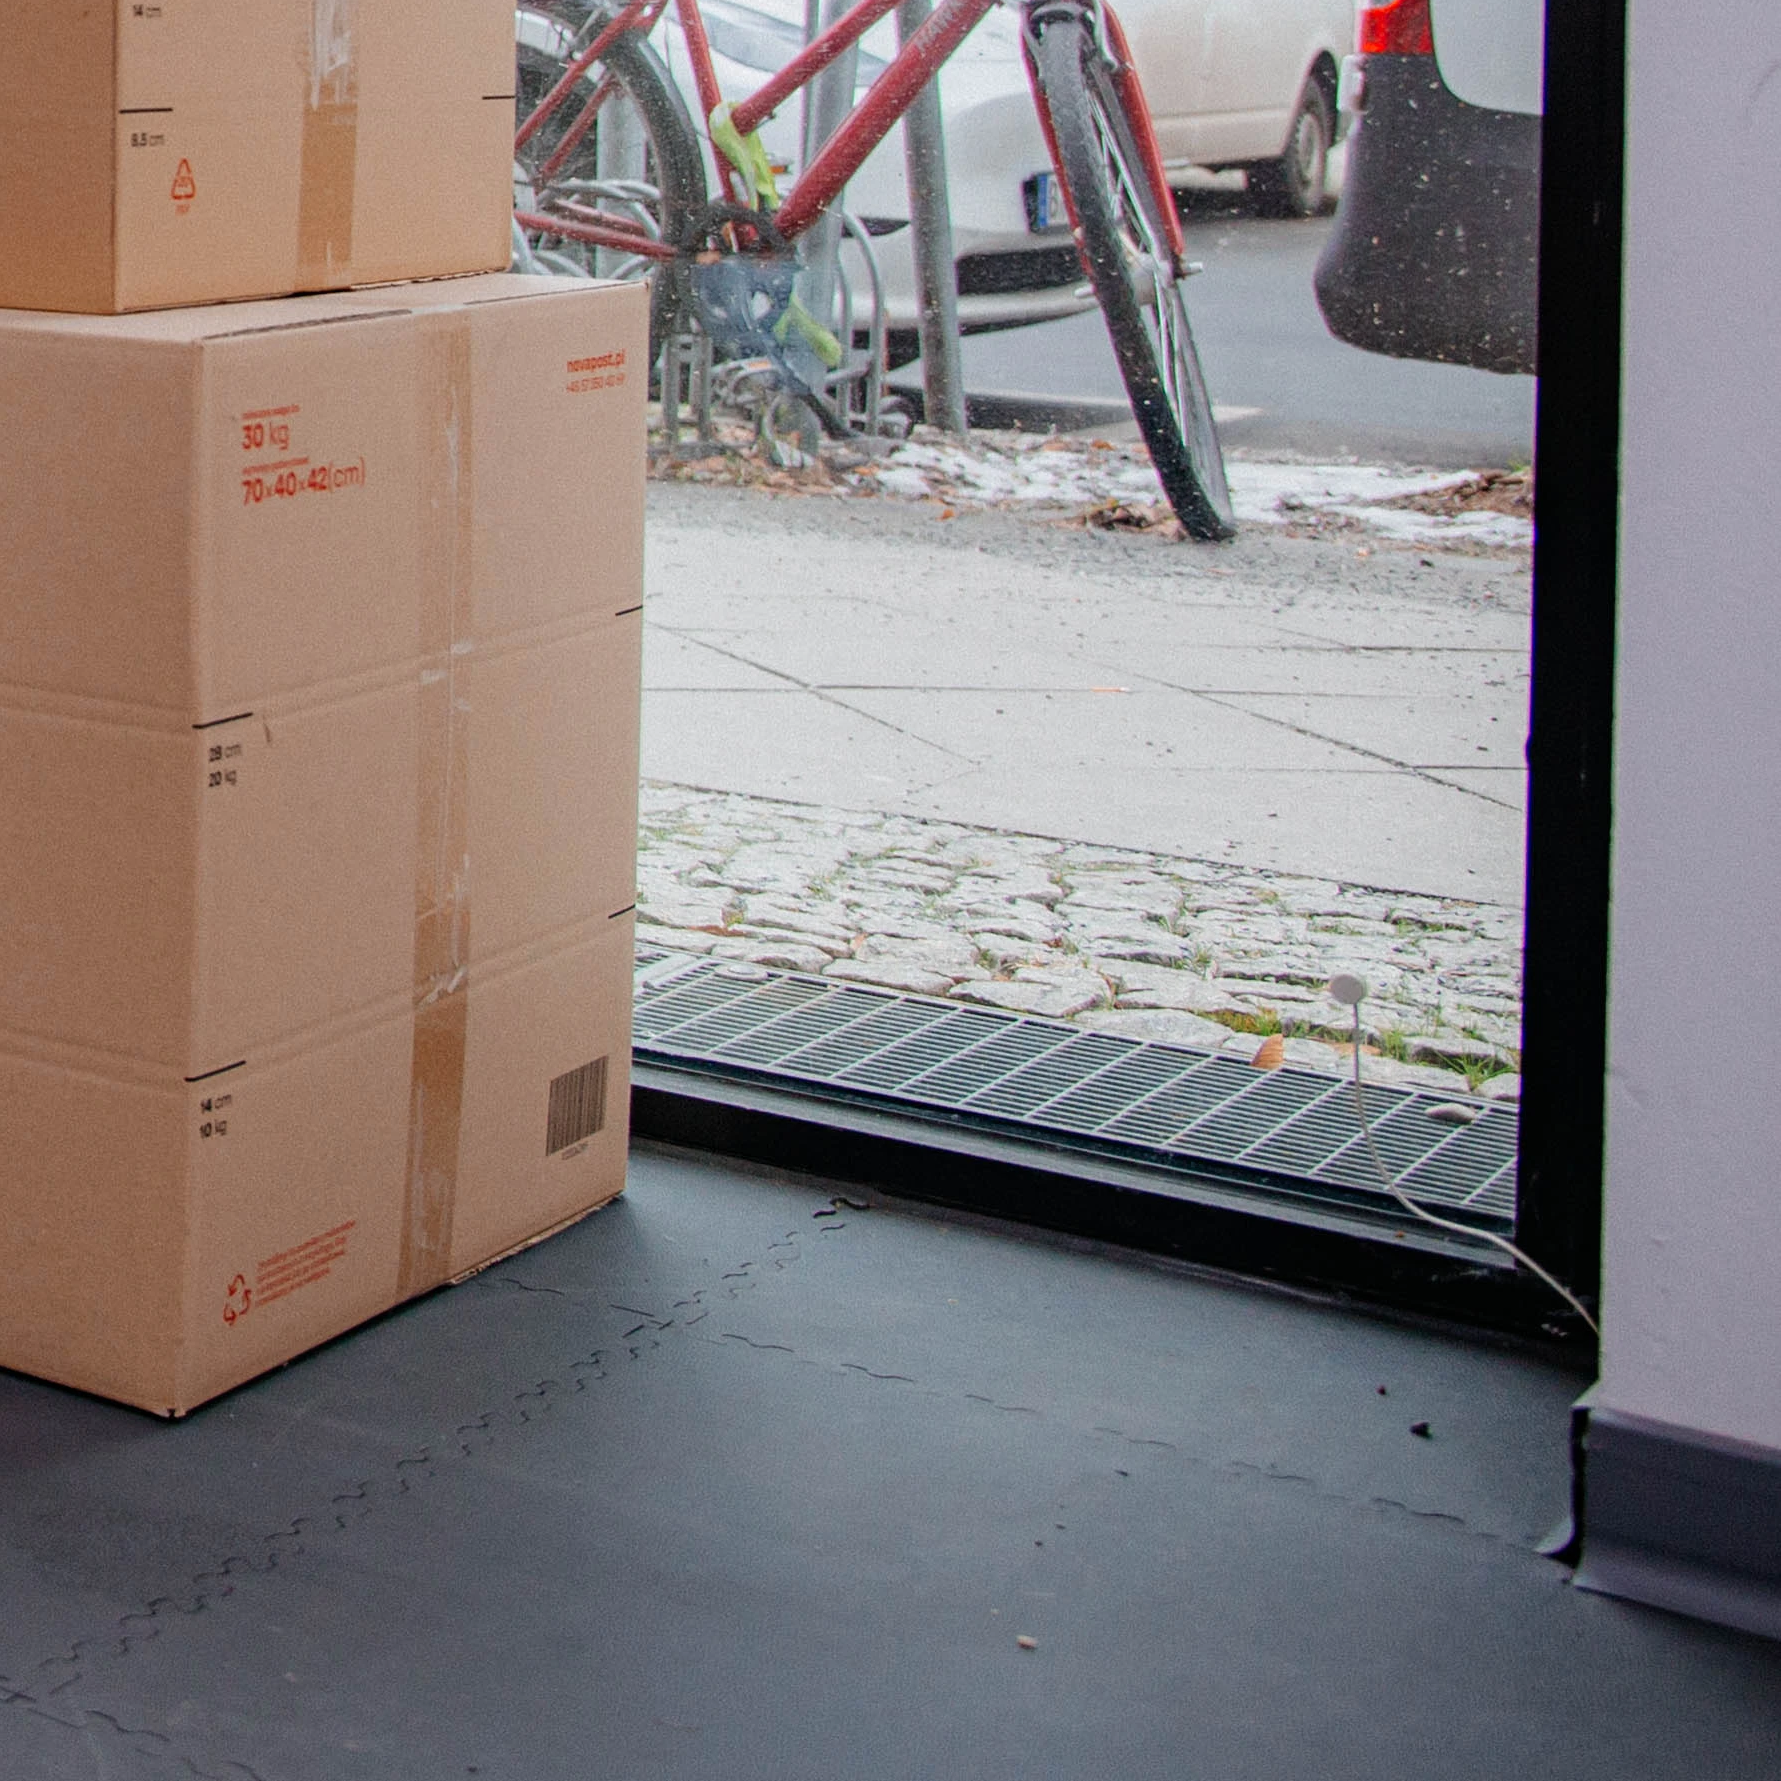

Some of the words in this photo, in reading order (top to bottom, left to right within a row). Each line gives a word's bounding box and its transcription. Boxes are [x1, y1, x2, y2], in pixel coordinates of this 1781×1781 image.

[566, 348, 626, 373] novapost.pl
[242, 423, 264, 450] 30
[269, 421, 289, 451] kg
[200, 1122, 212, 1138] 10
